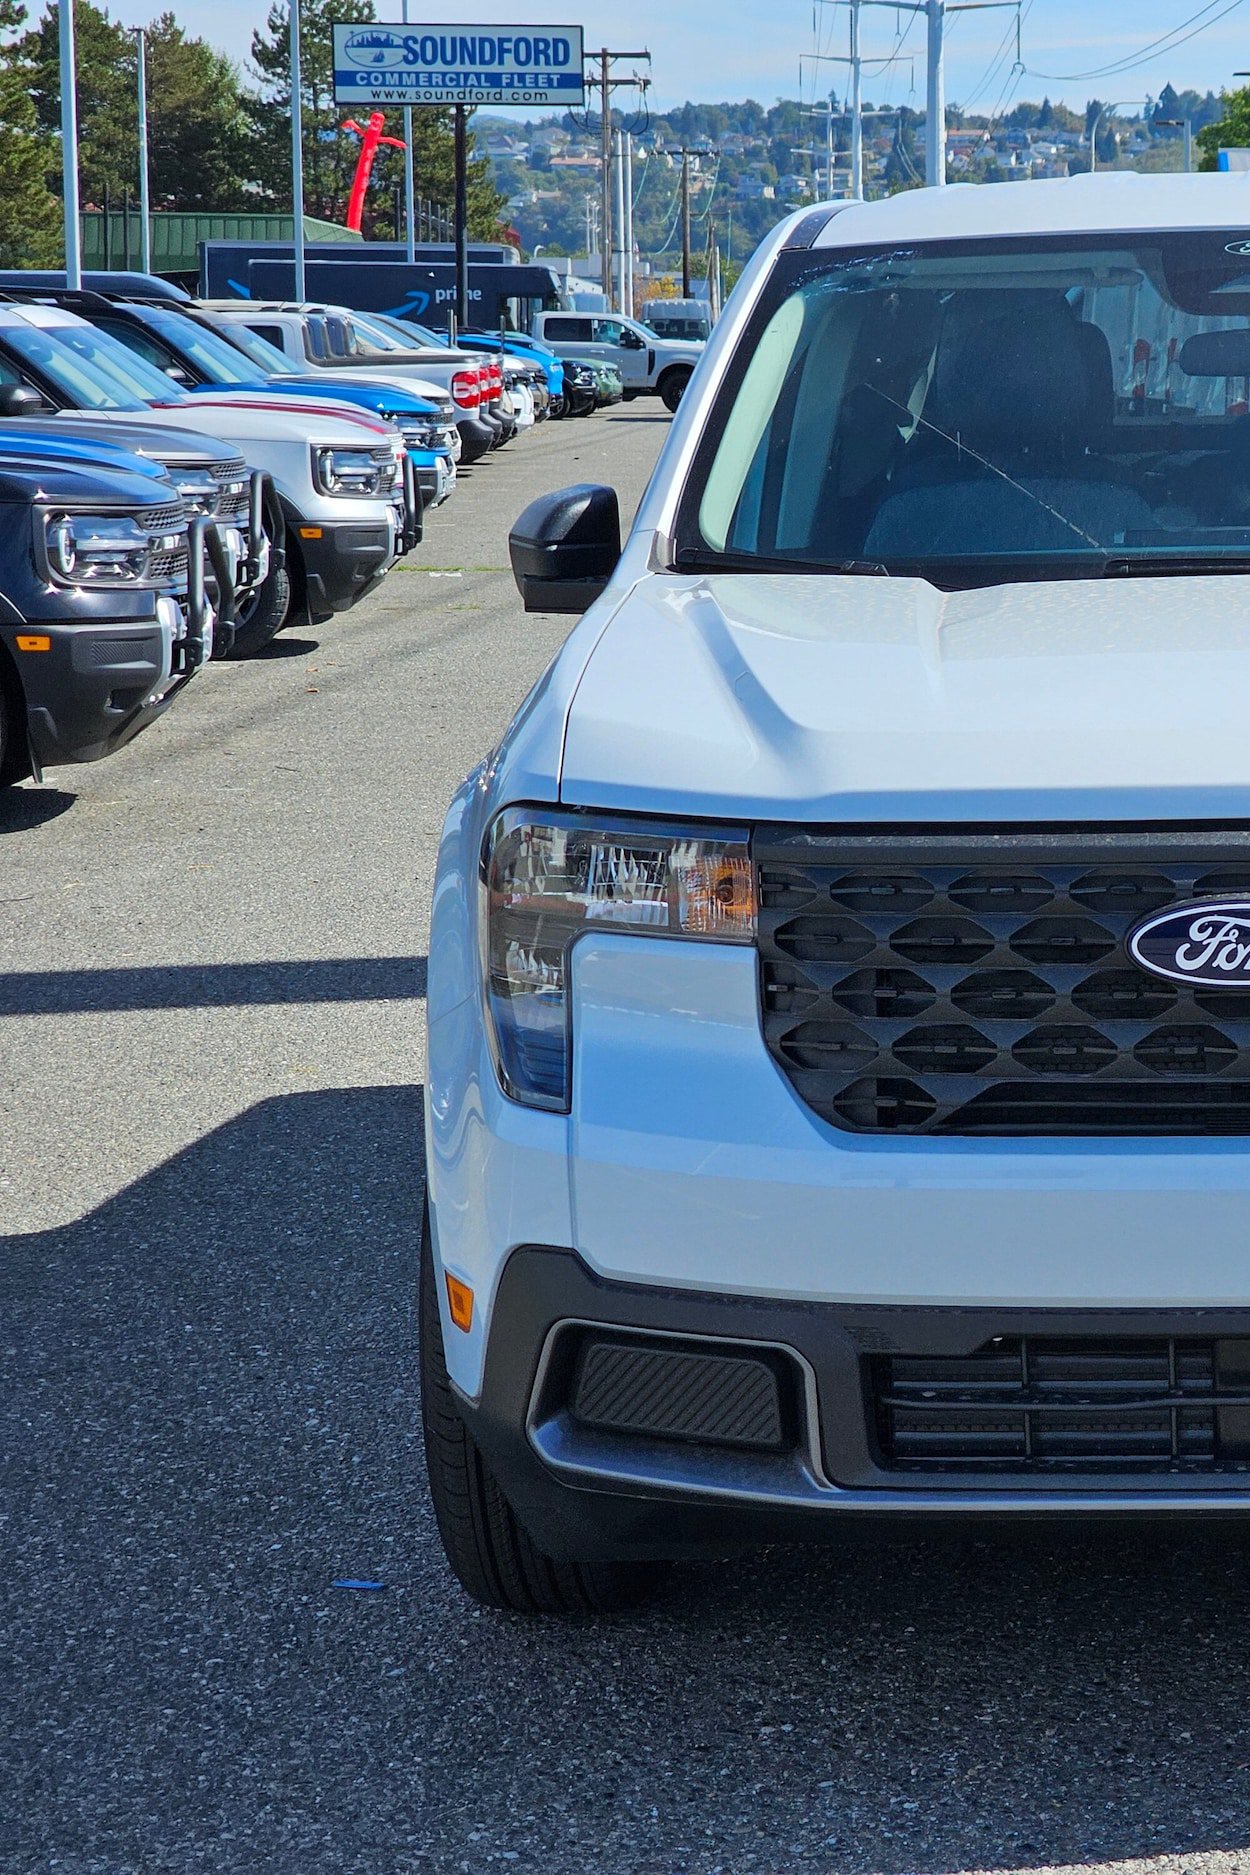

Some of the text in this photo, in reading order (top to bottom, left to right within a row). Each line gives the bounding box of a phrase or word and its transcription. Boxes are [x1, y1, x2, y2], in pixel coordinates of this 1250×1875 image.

[403, 35, 570, 67] SOUNDFORD
[355, 72, 561, 88] COMMERCIAL FLEET
[371, 88, 549, 101] www.soundford.com
